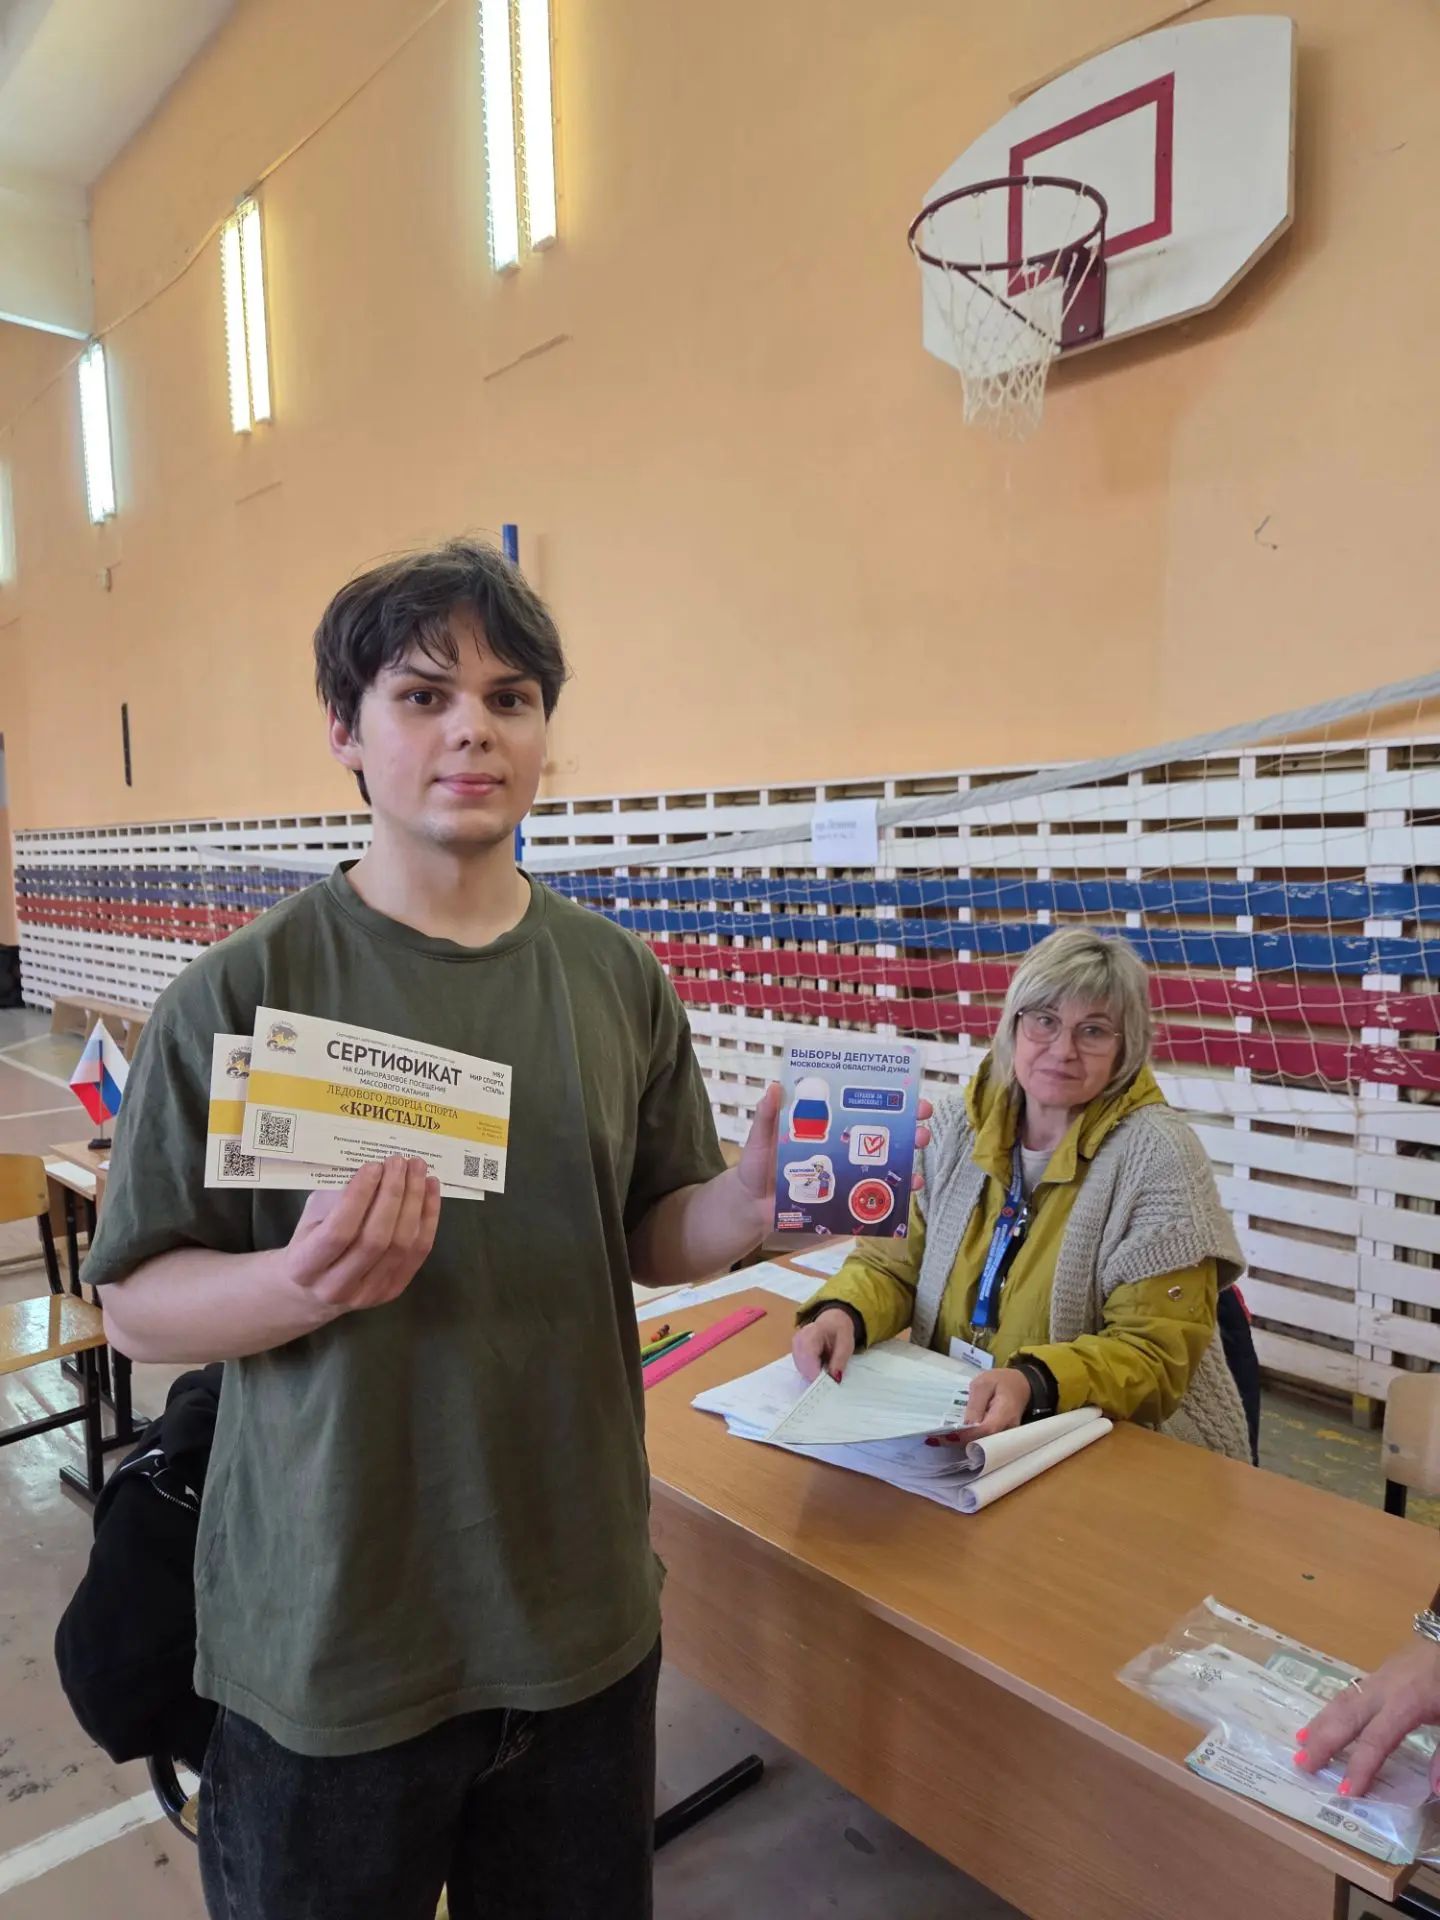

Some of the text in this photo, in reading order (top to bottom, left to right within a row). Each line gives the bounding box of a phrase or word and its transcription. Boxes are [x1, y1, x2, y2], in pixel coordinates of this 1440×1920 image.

[326, 1040, 462, 1086] СЕРТИФИКАТ
[790, 1060, 910, 1074] МОСКОВСКОЙ ОБЛАСТНОЙ ДУМЫ
[791, 1048, 911, 1064] ВЫБОРЫ ДЕПУТАТОВ
[342, 1065, 446, 1094] НА ЕДИНОРАЗОВОЕ ПОСЕЩЕНИЯ
[359, 1078, 430, 1098] МАССОВОГО КАТАНИЯ
[483, 1077, 504, 1087] СПОРТА
[326, 1084, 458, 1119] ЛЕДОВОГО ДВОРЦА СПОРТА
[339, 1101, 441, 1130] «КРИСТАЛЛ»
